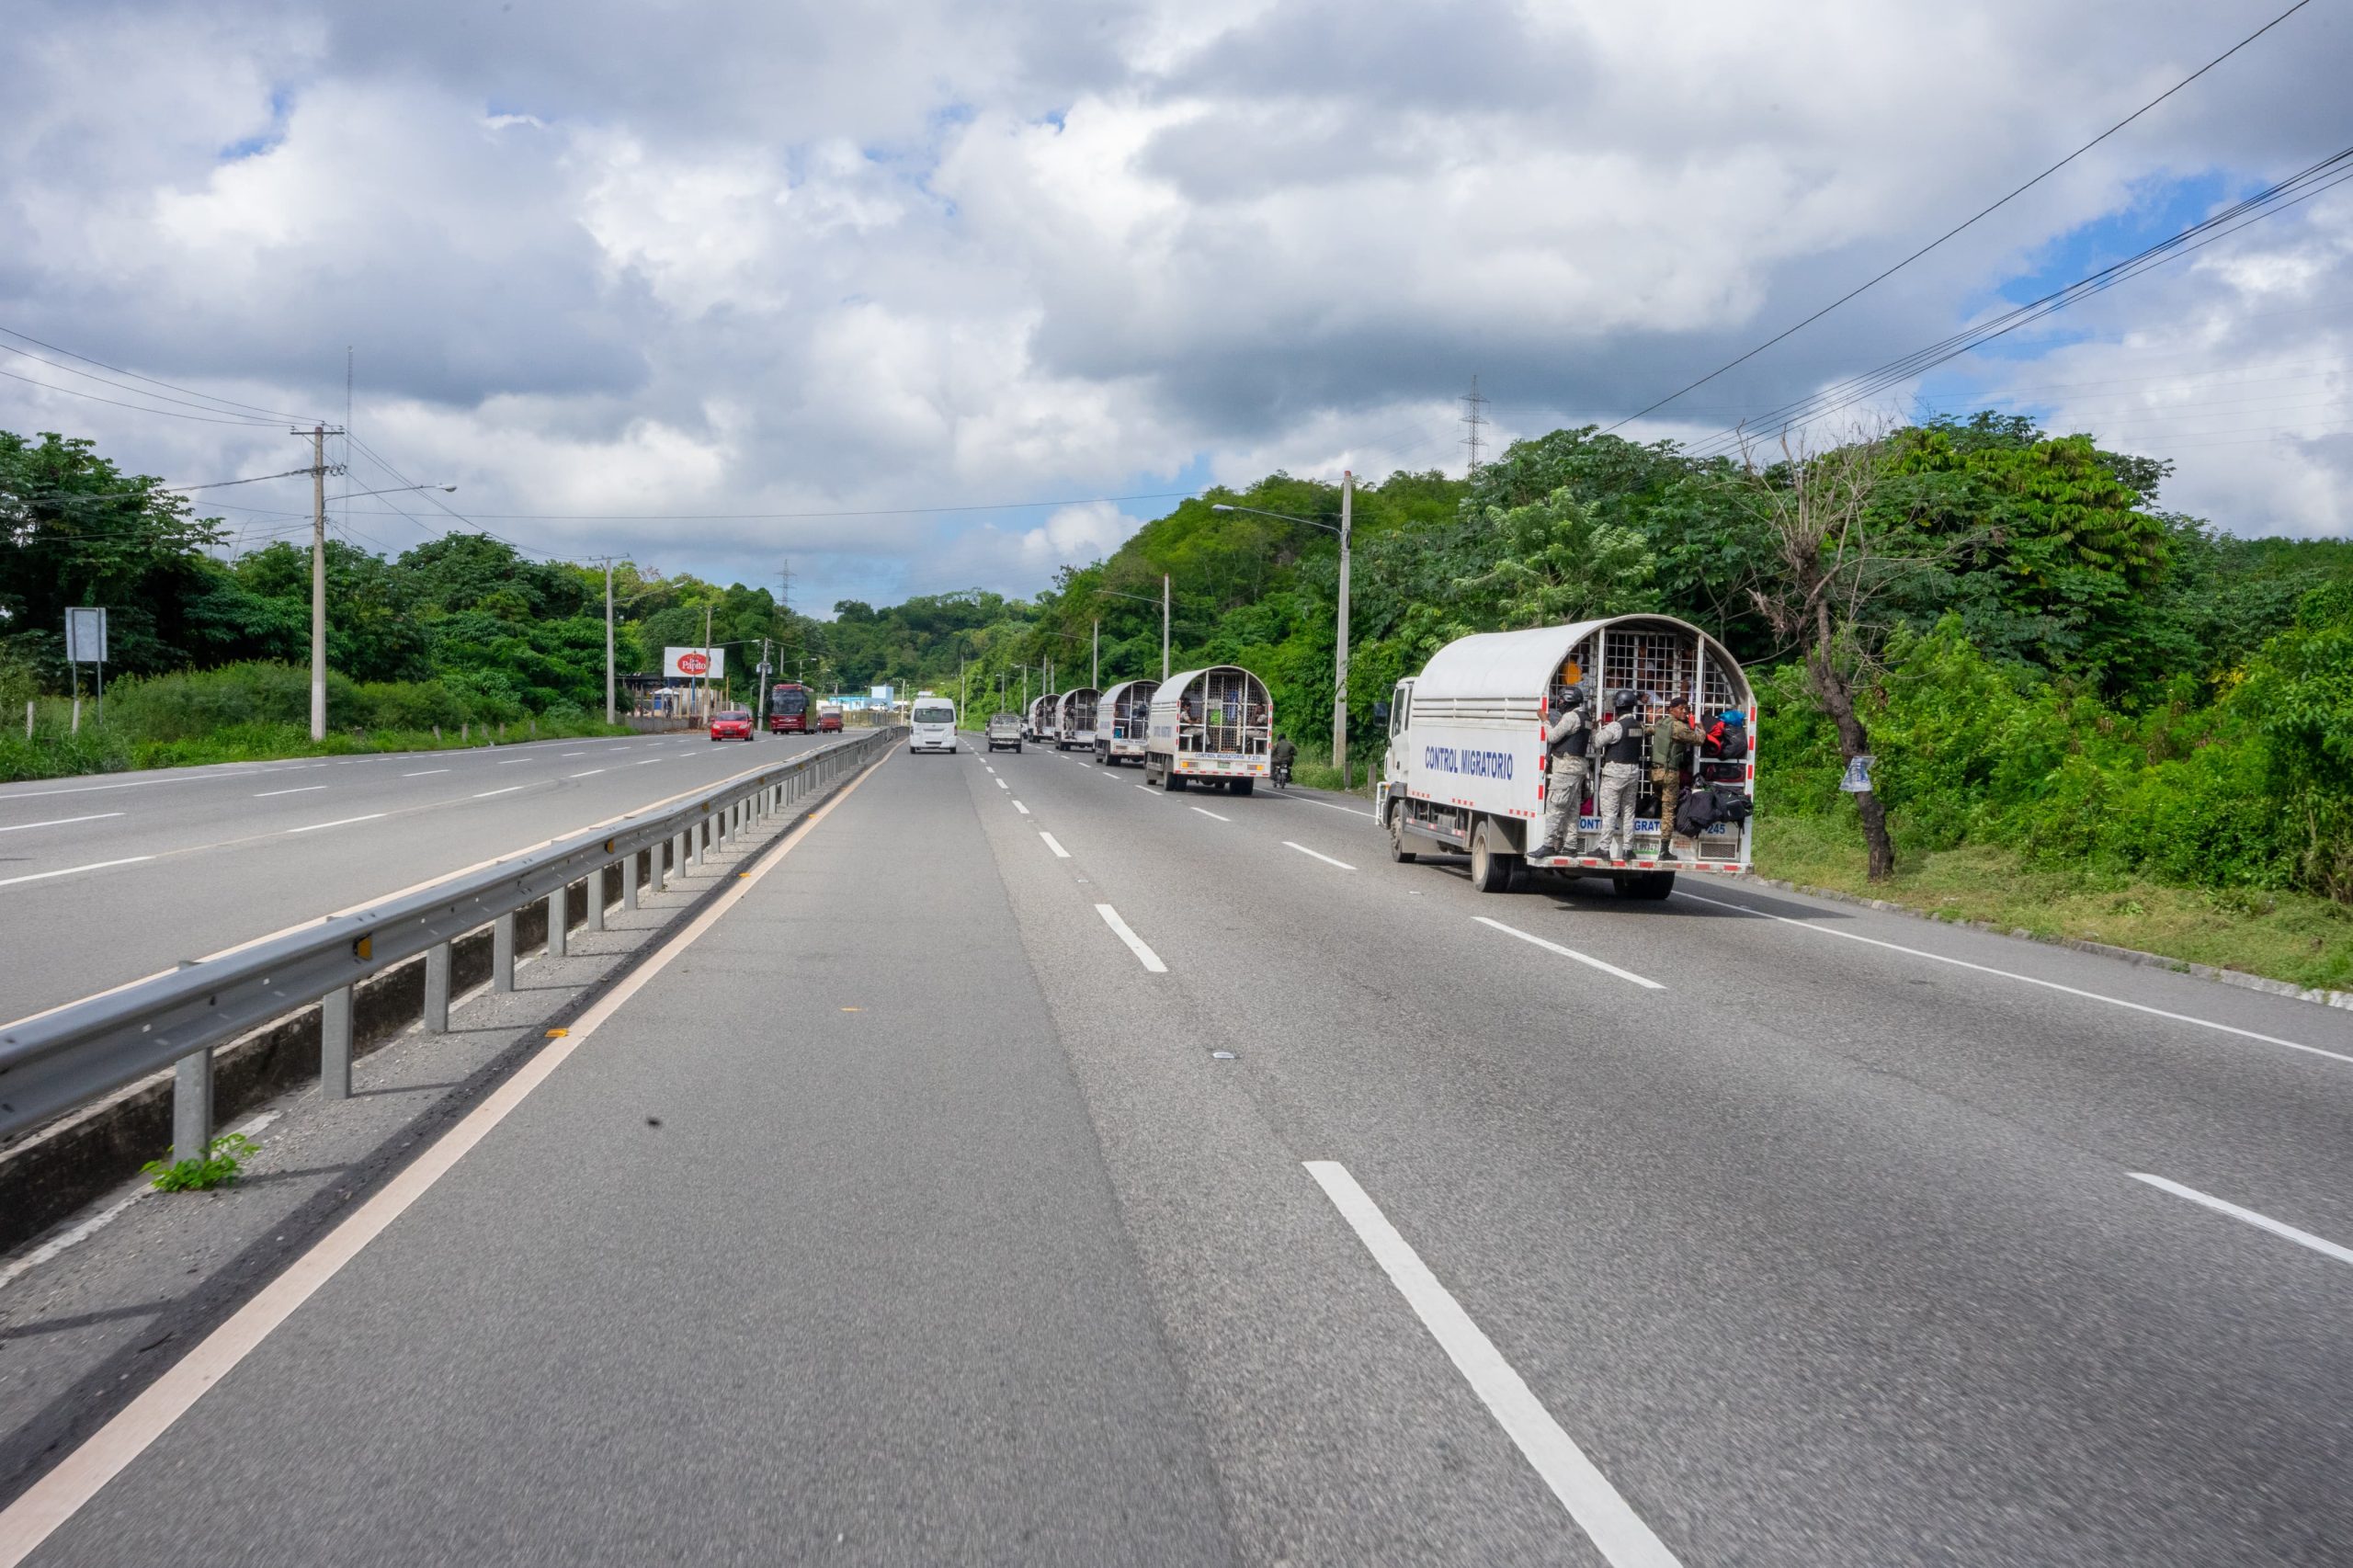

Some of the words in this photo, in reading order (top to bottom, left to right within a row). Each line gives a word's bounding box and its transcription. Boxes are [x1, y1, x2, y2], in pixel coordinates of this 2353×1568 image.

[682, 660, 706, 672] Papito
[1426, 745, 1458, 773] CONTROL
[1461, 749, 1513, 780] MIGRATORIO
